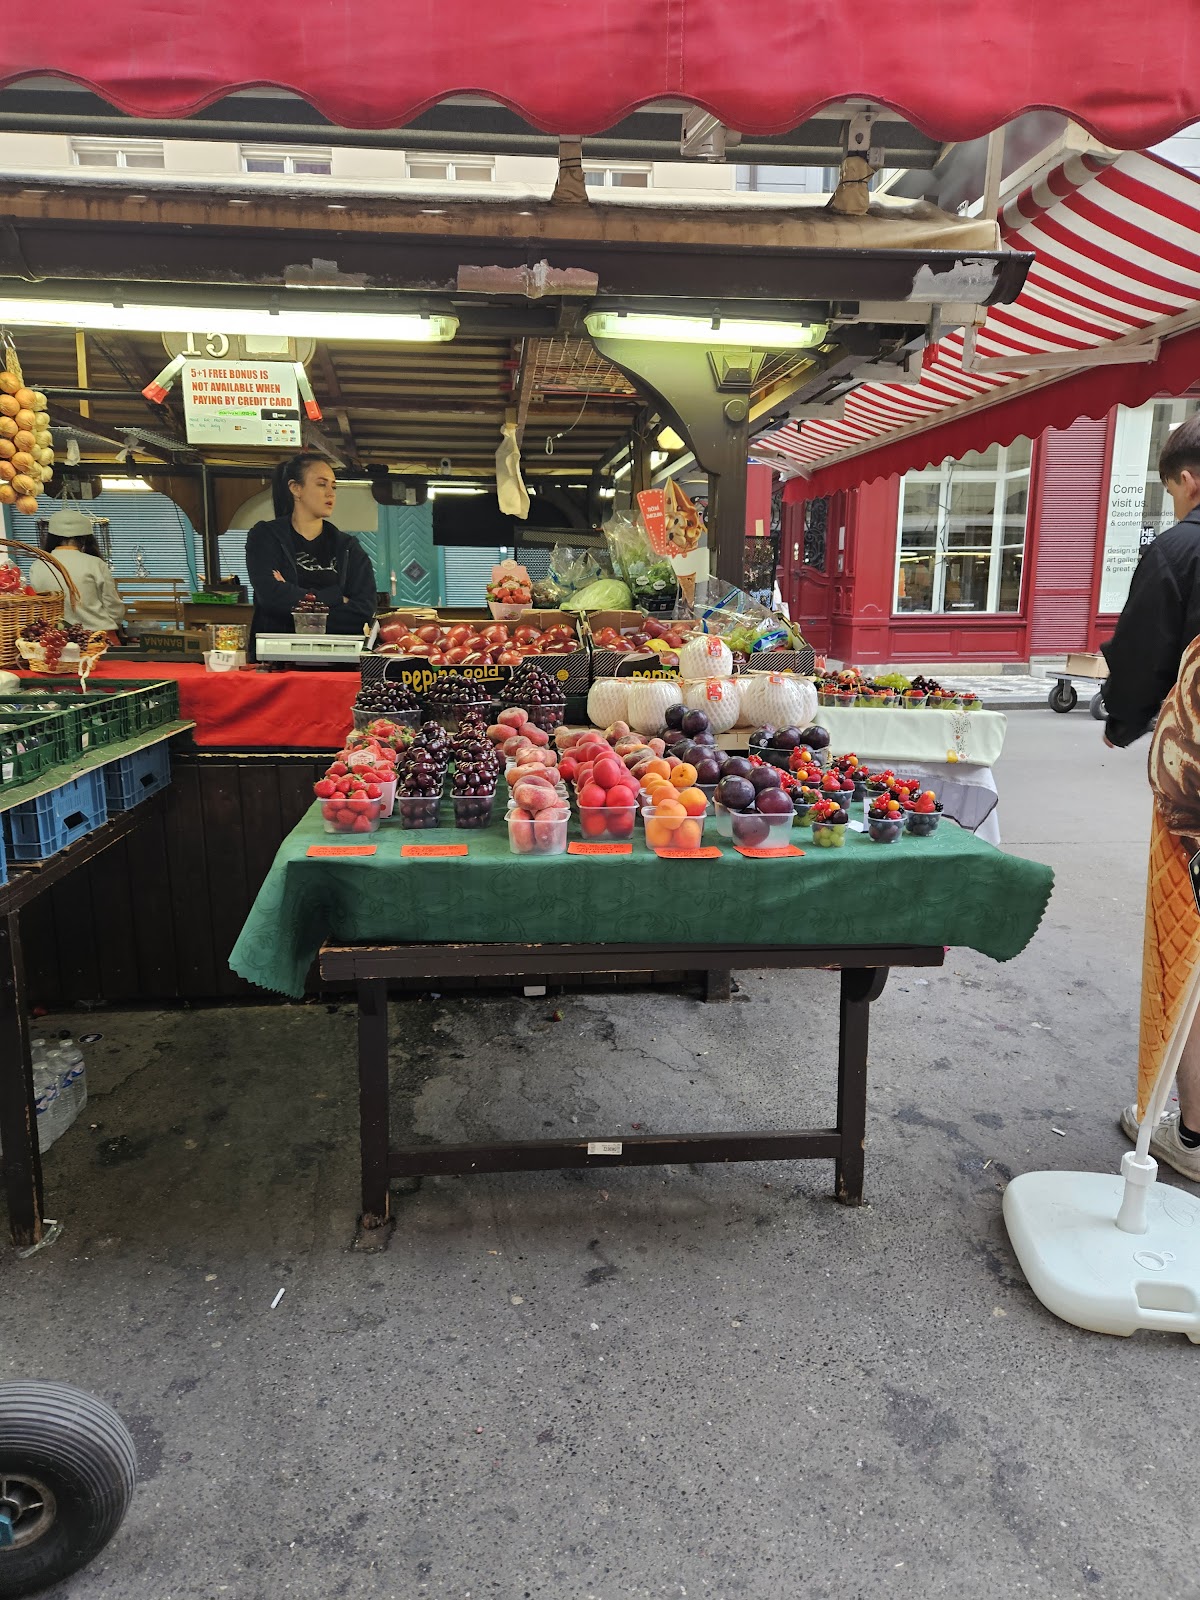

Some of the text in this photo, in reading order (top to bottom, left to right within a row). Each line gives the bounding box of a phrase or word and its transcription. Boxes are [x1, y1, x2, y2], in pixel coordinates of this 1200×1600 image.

[182, 332, 230, 358] 15
[190, 368, 269, 380] 5+1 FREE BONUS IS
[191, 382, 281, 394] NOT AVAILABLE WHEN
[193, 395, 292, 407] PAYING BY CREDIT CARD
[1113, 484, 1144, 494] Come
[1111, 498, 1132, 508] visit
[1117, 520, 1165, 528] contemporary
[1138, 528, 1155, 537] THE
[1107, 547, 1131, 555] design
[144, 637, 183, 648] BANANA
[463, 665, 499, 680] gold
